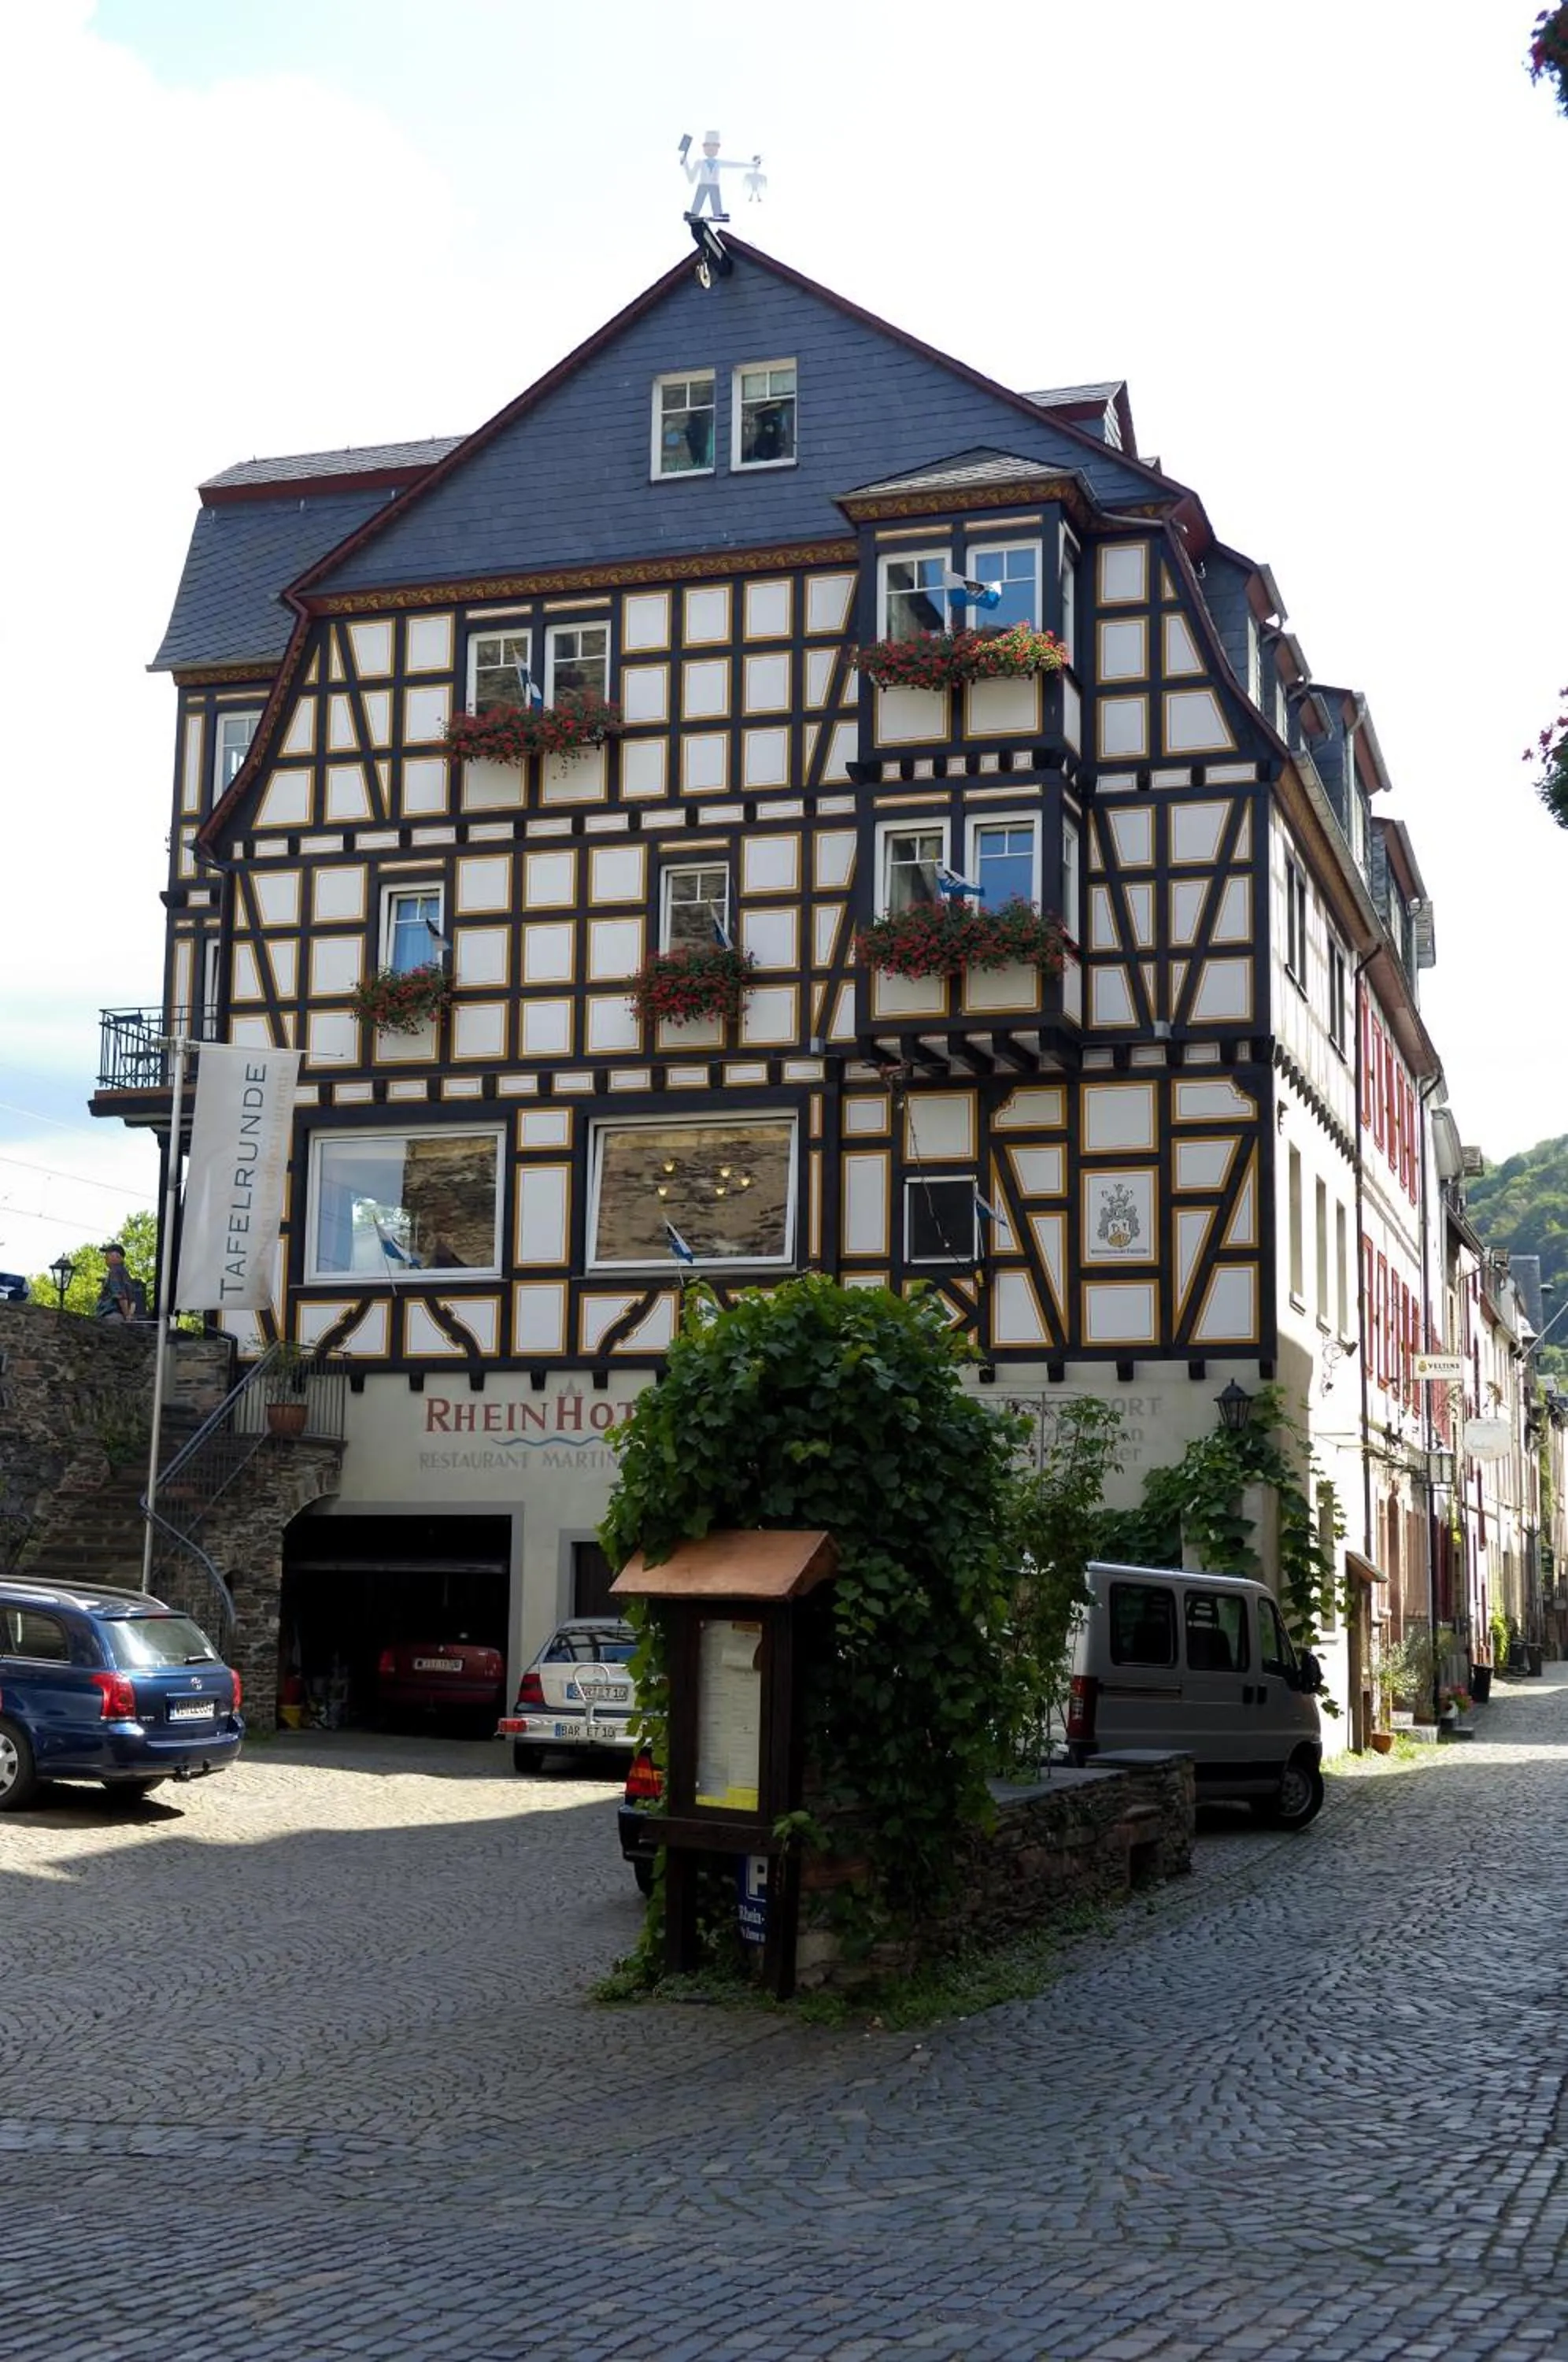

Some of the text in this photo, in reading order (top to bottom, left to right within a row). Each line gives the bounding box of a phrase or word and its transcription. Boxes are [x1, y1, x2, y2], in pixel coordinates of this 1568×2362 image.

[220, 1062, 267, 1301] TAFELRUNDE
[419, 1452, 529, 1470] RESTAURANT
[749, 1855, 768, 1896] P
